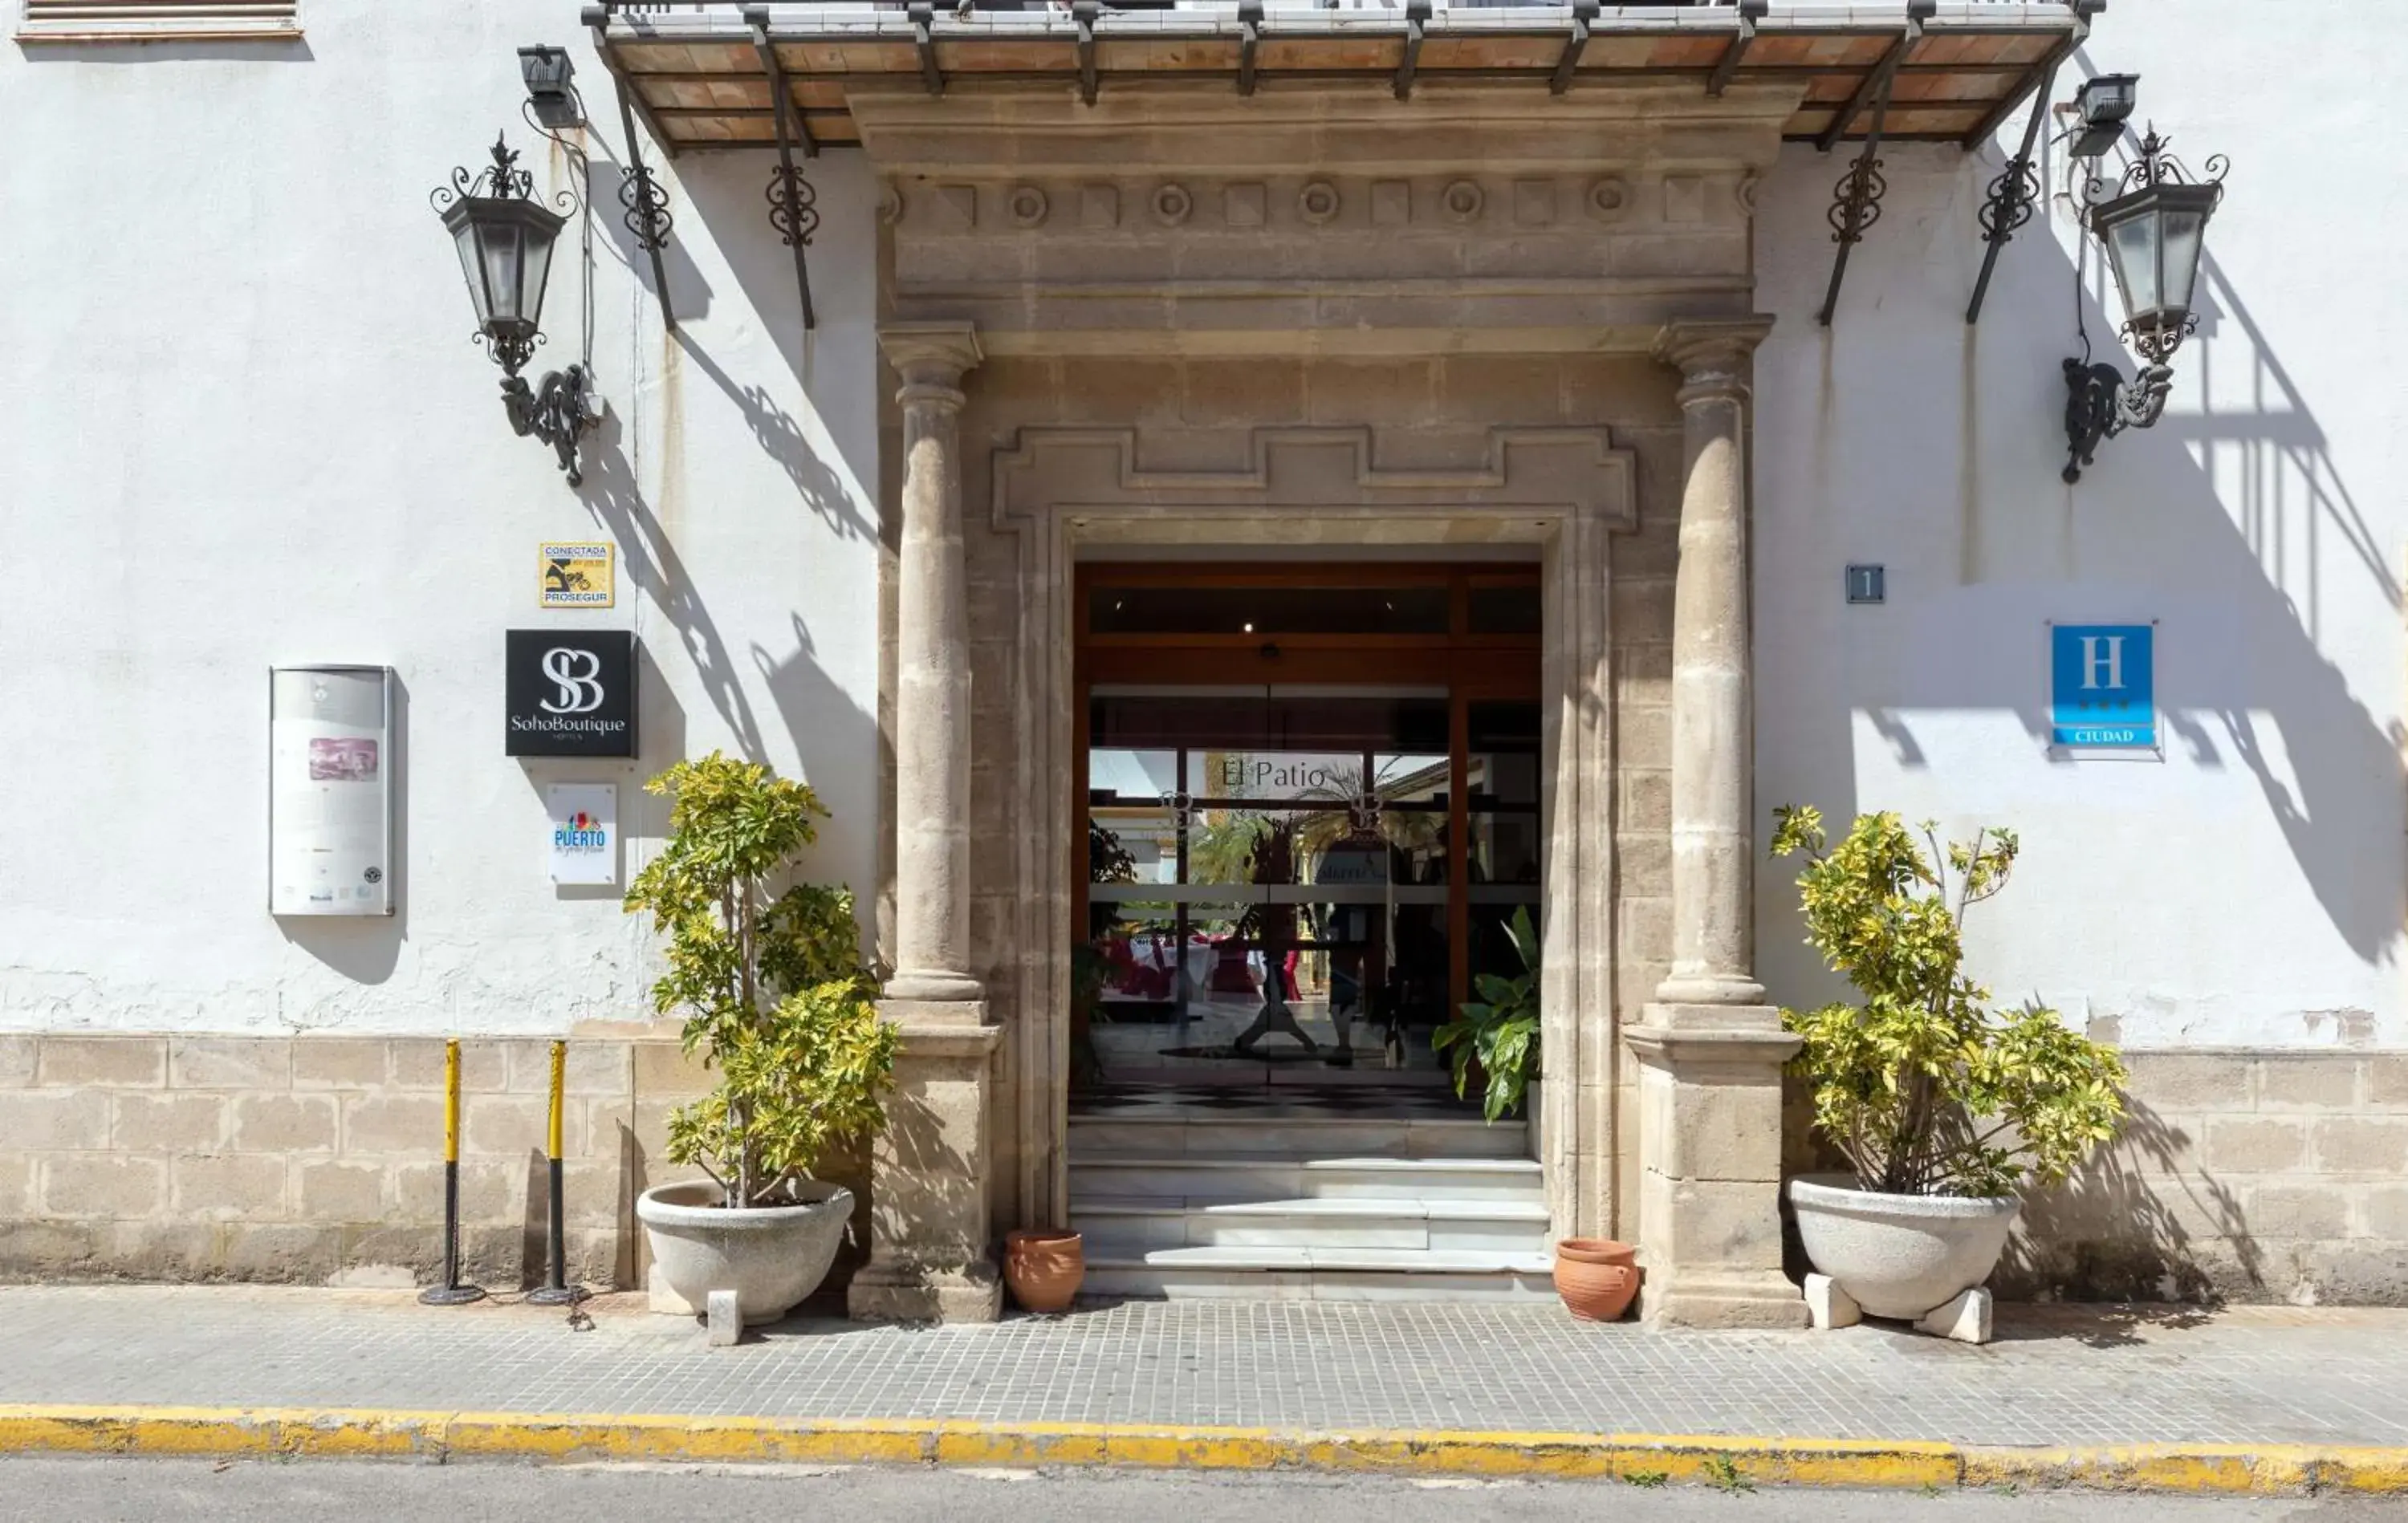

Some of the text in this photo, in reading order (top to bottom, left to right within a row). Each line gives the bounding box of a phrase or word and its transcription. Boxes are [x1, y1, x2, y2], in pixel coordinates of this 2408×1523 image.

[1861, 571, 1871, 596] 1
[545, 593, 607, 601] PROSEGUR
[2078, 636, 2128, 689] H
[511, 714, 625, 737] SohoBoutique
[2075, 730, 2135, 742] CIUDAD
[1223, 759, 1326, 786] El Patio
[555, 831, 605, 847] PUERTO
